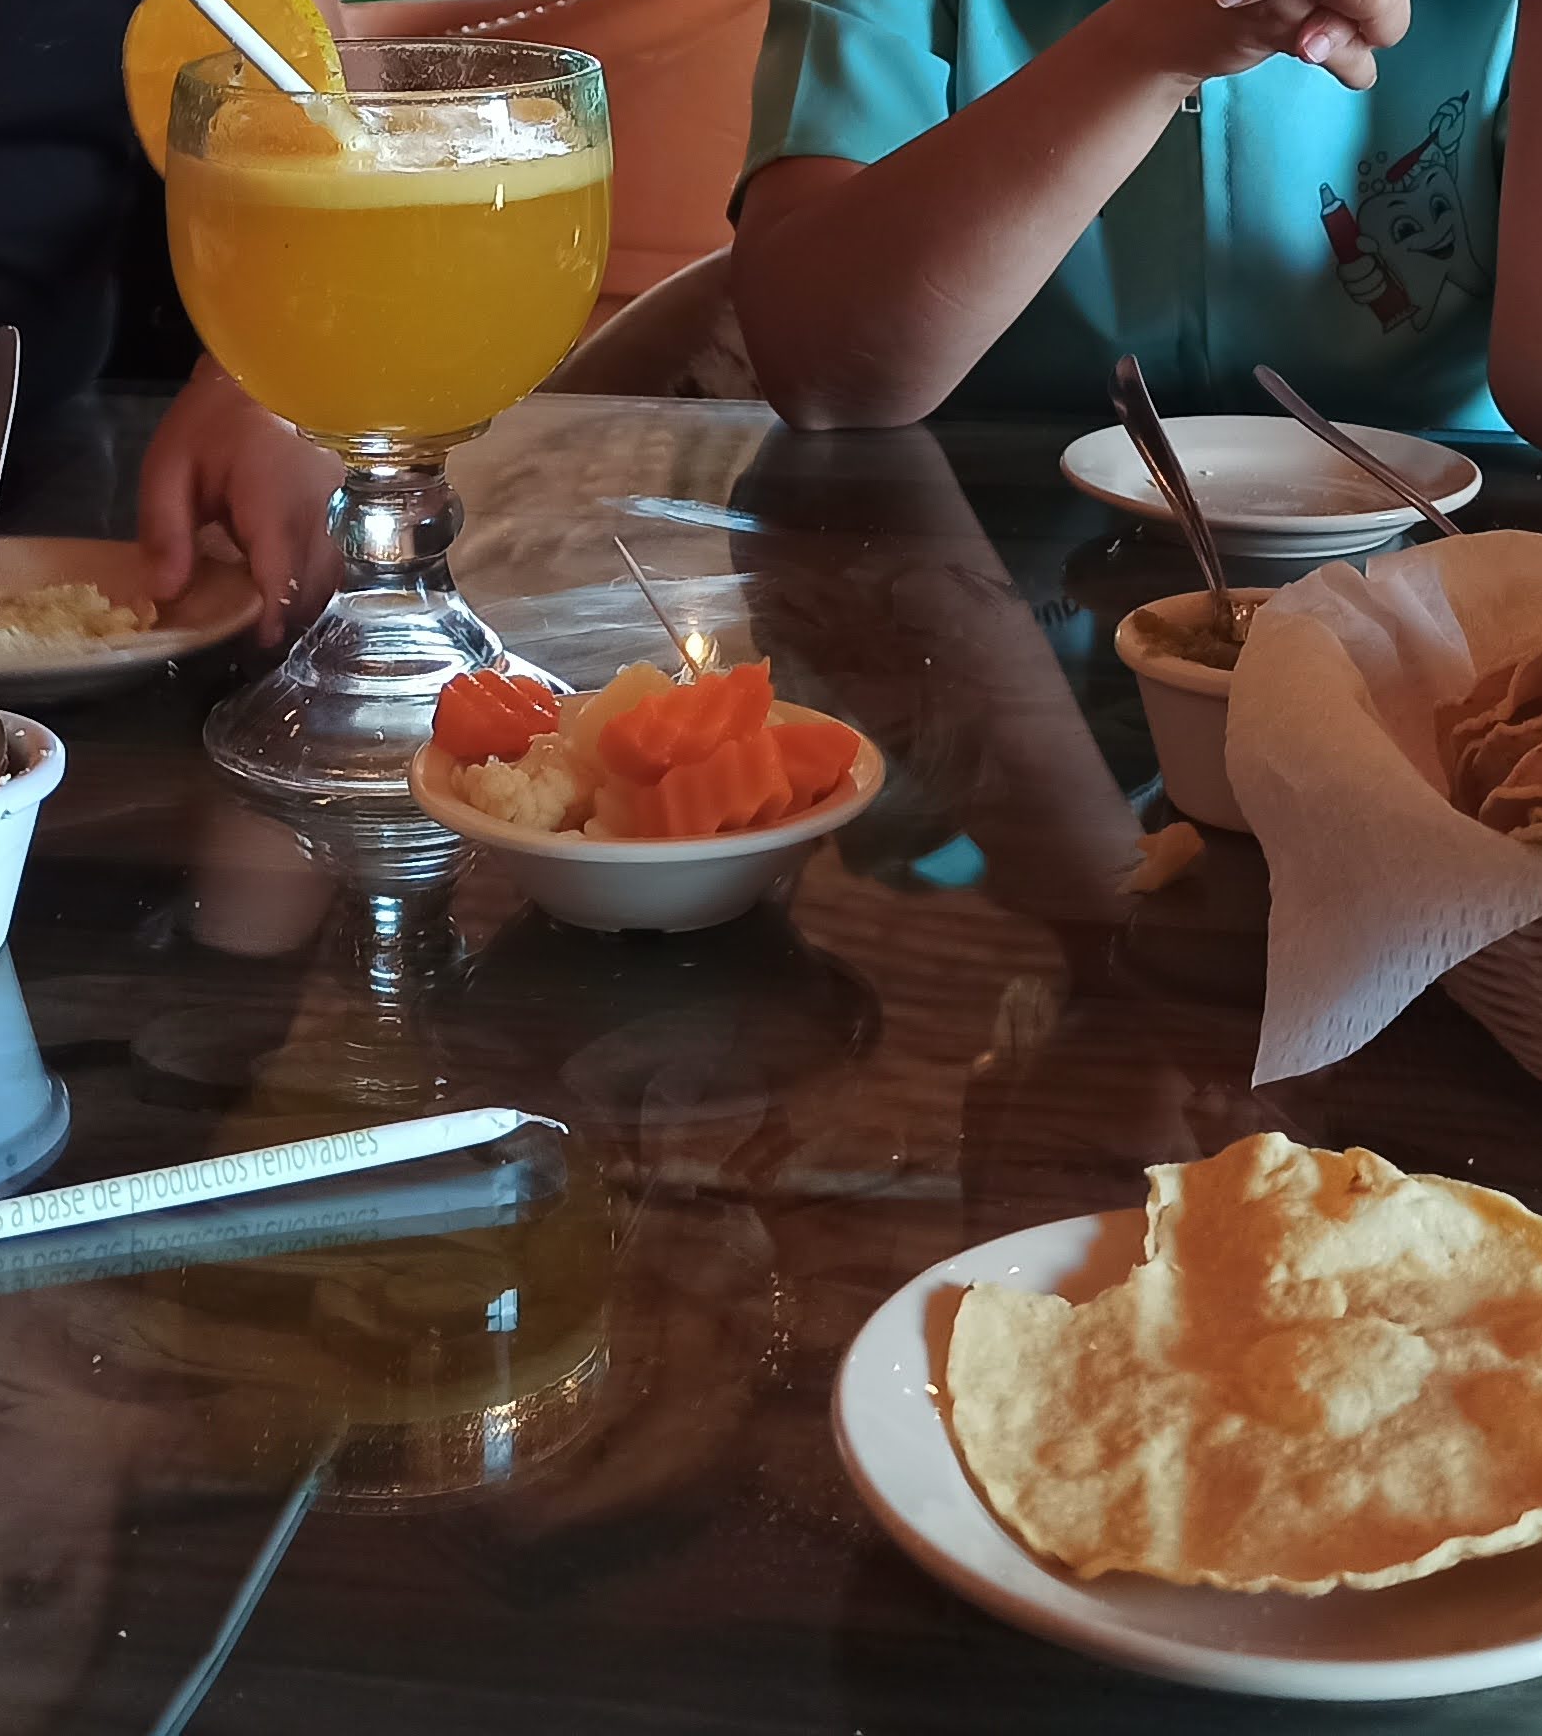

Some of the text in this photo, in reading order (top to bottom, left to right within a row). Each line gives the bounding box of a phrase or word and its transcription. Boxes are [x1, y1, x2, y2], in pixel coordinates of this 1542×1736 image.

[11, 1200, 24, 1227] a
[31, 1188, 86, 1224] base
[91, 1180, 122, 1211] de
[128, 1156, 249, 1214] productos
[255, 1127, 380, 1180] renovables
